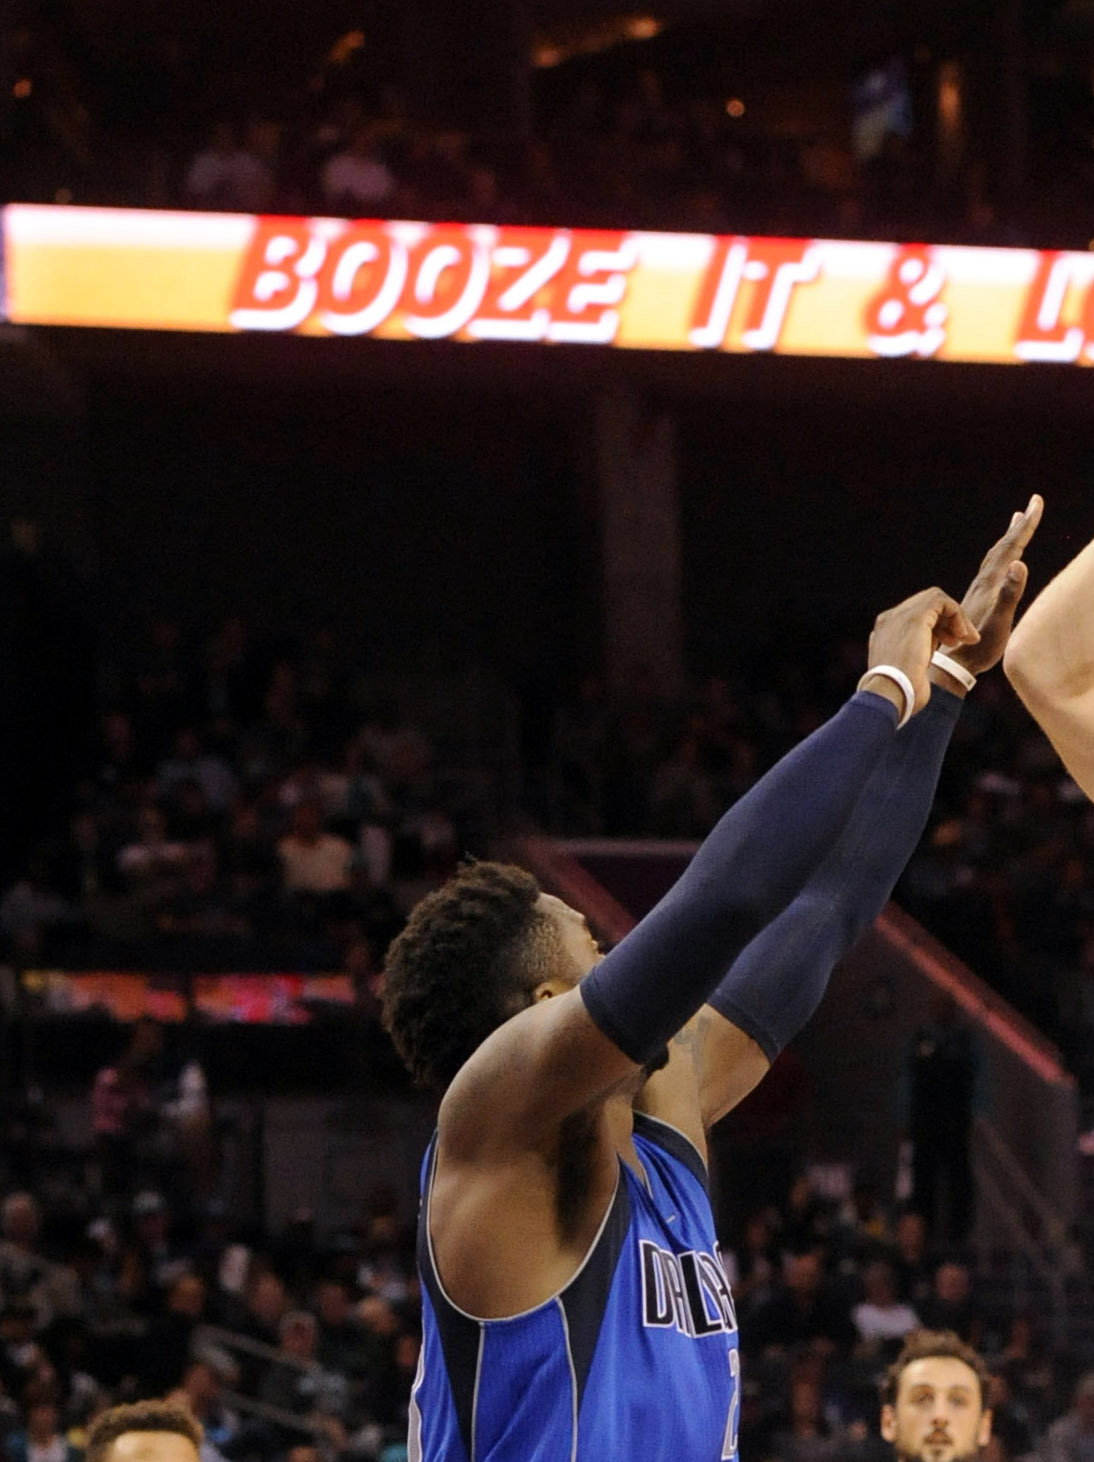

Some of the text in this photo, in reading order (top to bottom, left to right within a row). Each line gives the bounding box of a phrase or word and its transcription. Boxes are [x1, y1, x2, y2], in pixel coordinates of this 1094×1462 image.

[229, 214, 638, 344] BOOZE
[688, 234, 822, 350] IT
[864, 242, 946, 357] &
